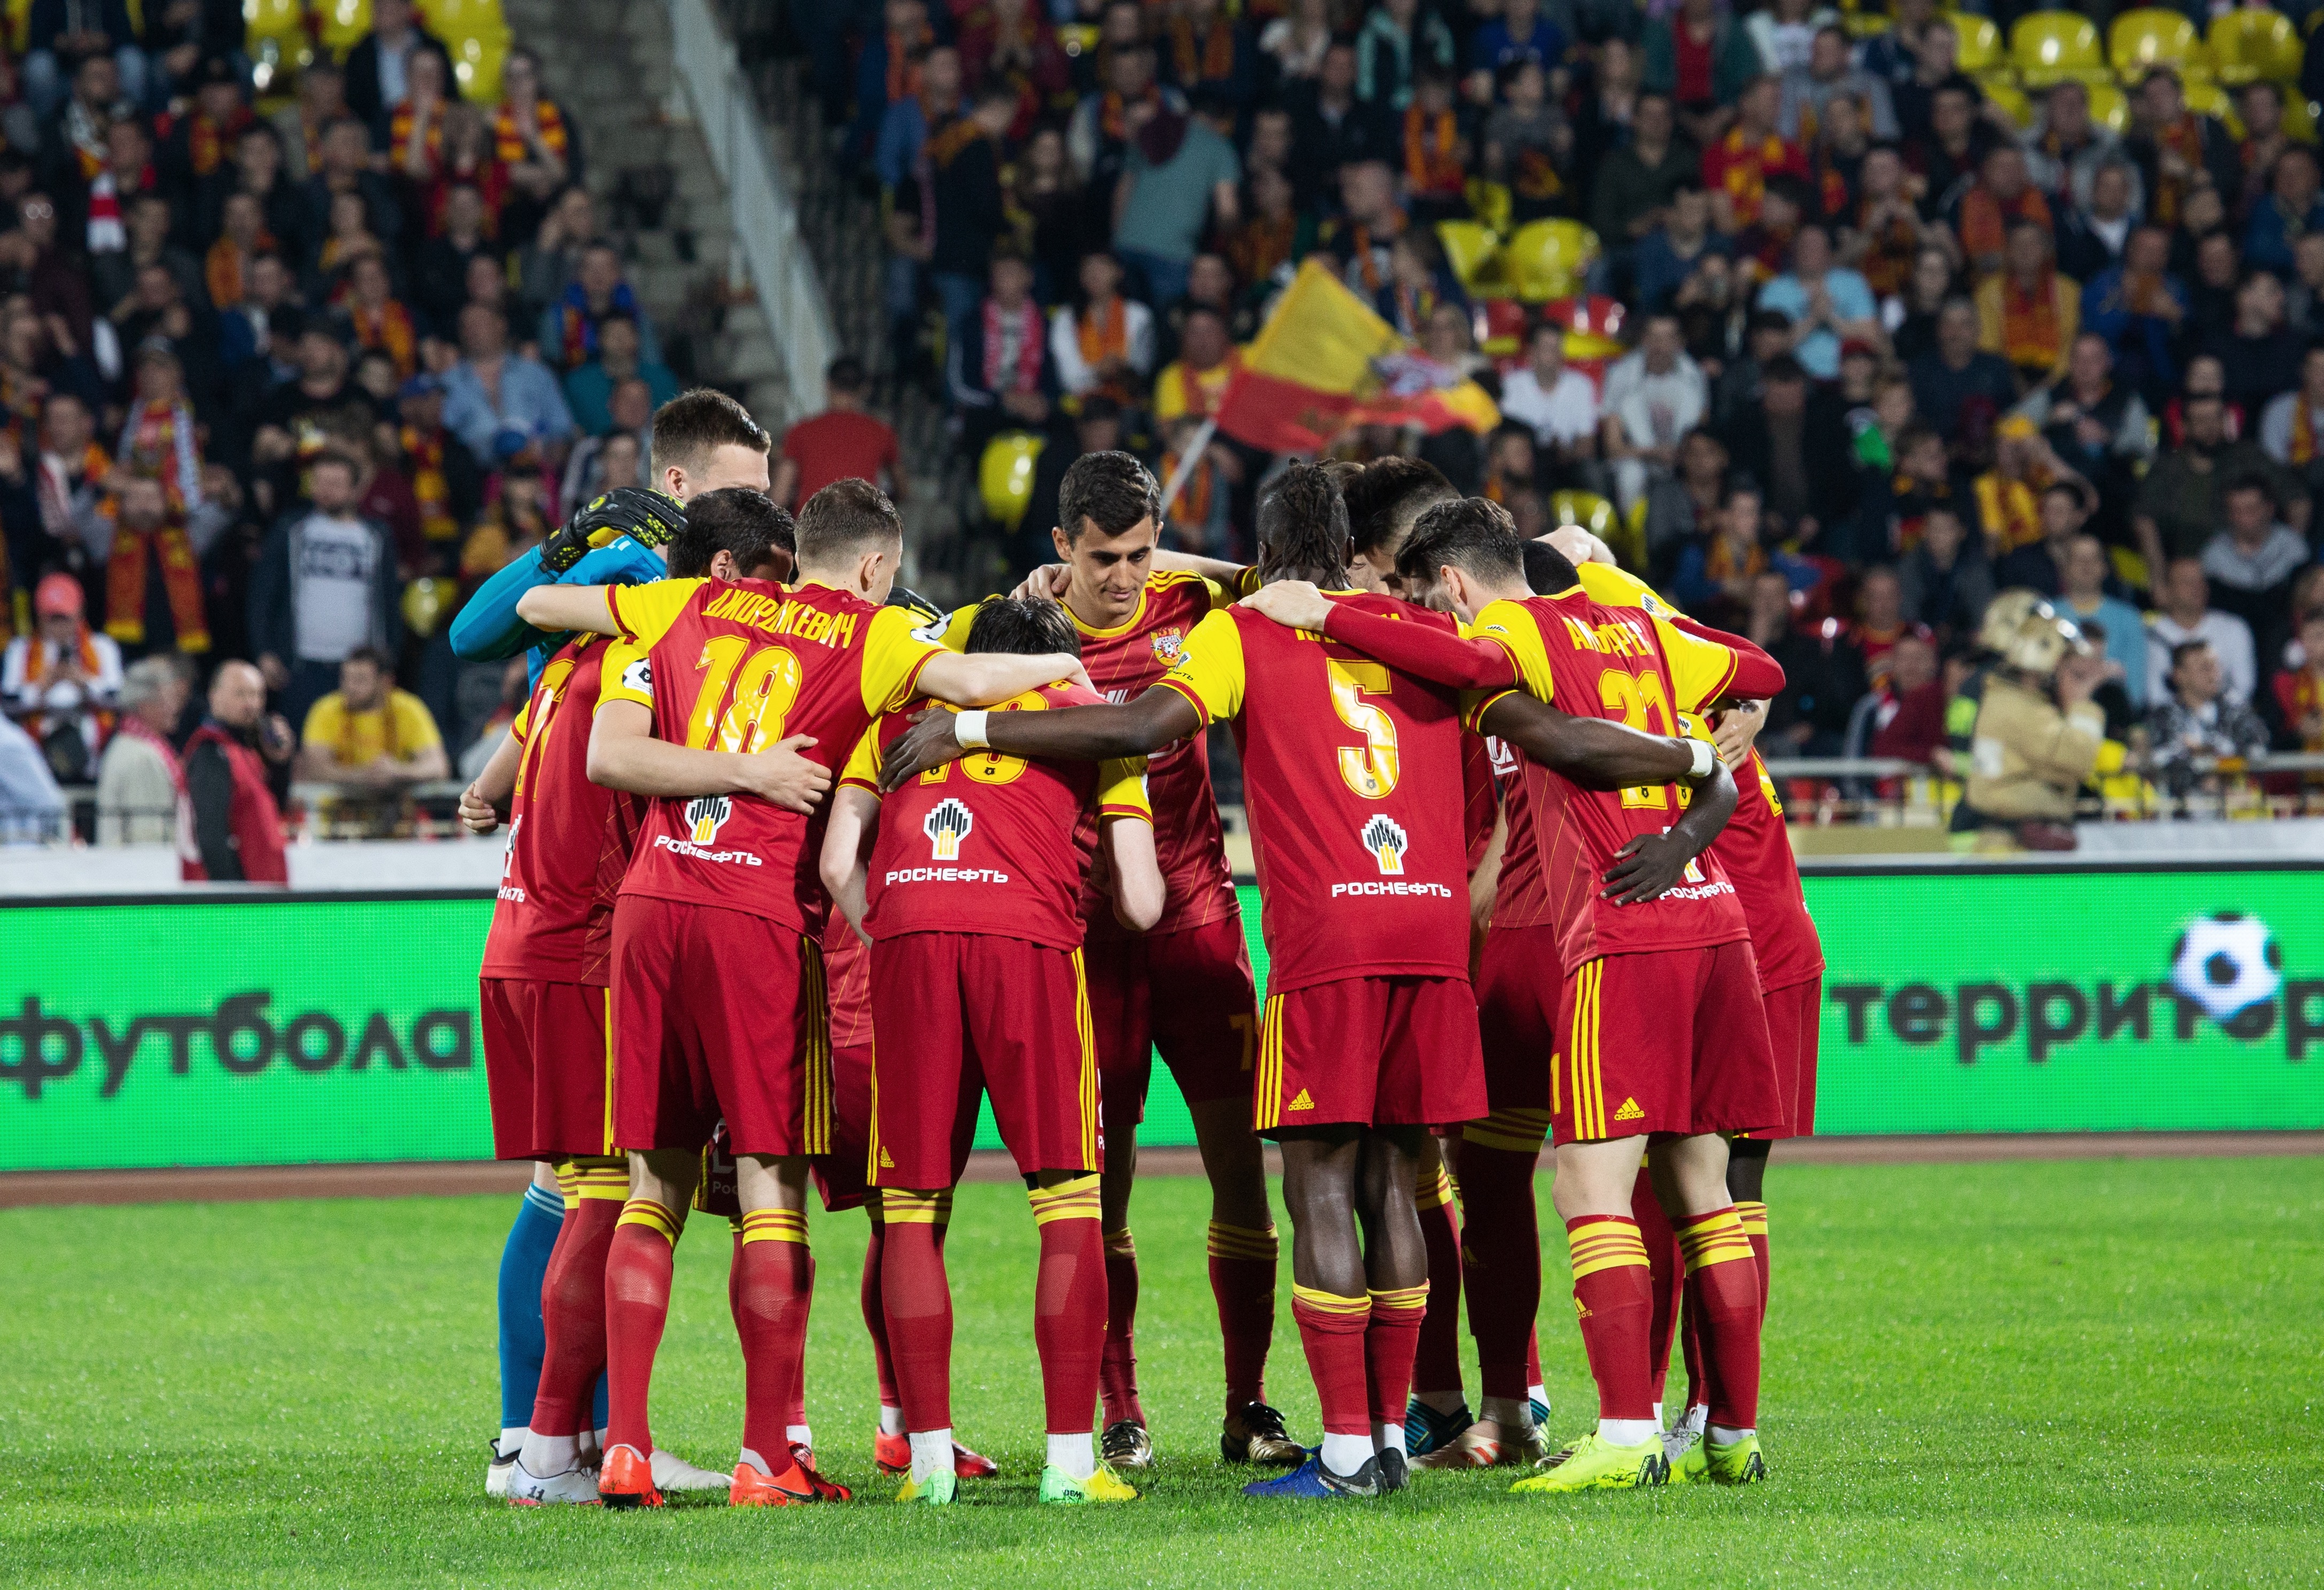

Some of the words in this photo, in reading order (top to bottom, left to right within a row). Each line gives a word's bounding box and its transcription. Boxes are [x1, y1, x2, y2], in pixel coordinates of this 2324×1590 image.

[685, 634, 803, 755] 18
[1326, 658, 1400, 800] 5
[654, 835, 763, 866] РОСНЕФТЬ
[885, 866, 1009, 886] РОСНЕФТЬ
[1331, 881, 1452, 898] РОСНЕФТЬ
[0, 991, 474, 1099] футбола
[1288, 1101, 1314, 1111] adidas
[1614, 1110, 1645, 1121] adidas
[527, 1485, 545, 1501] 11
